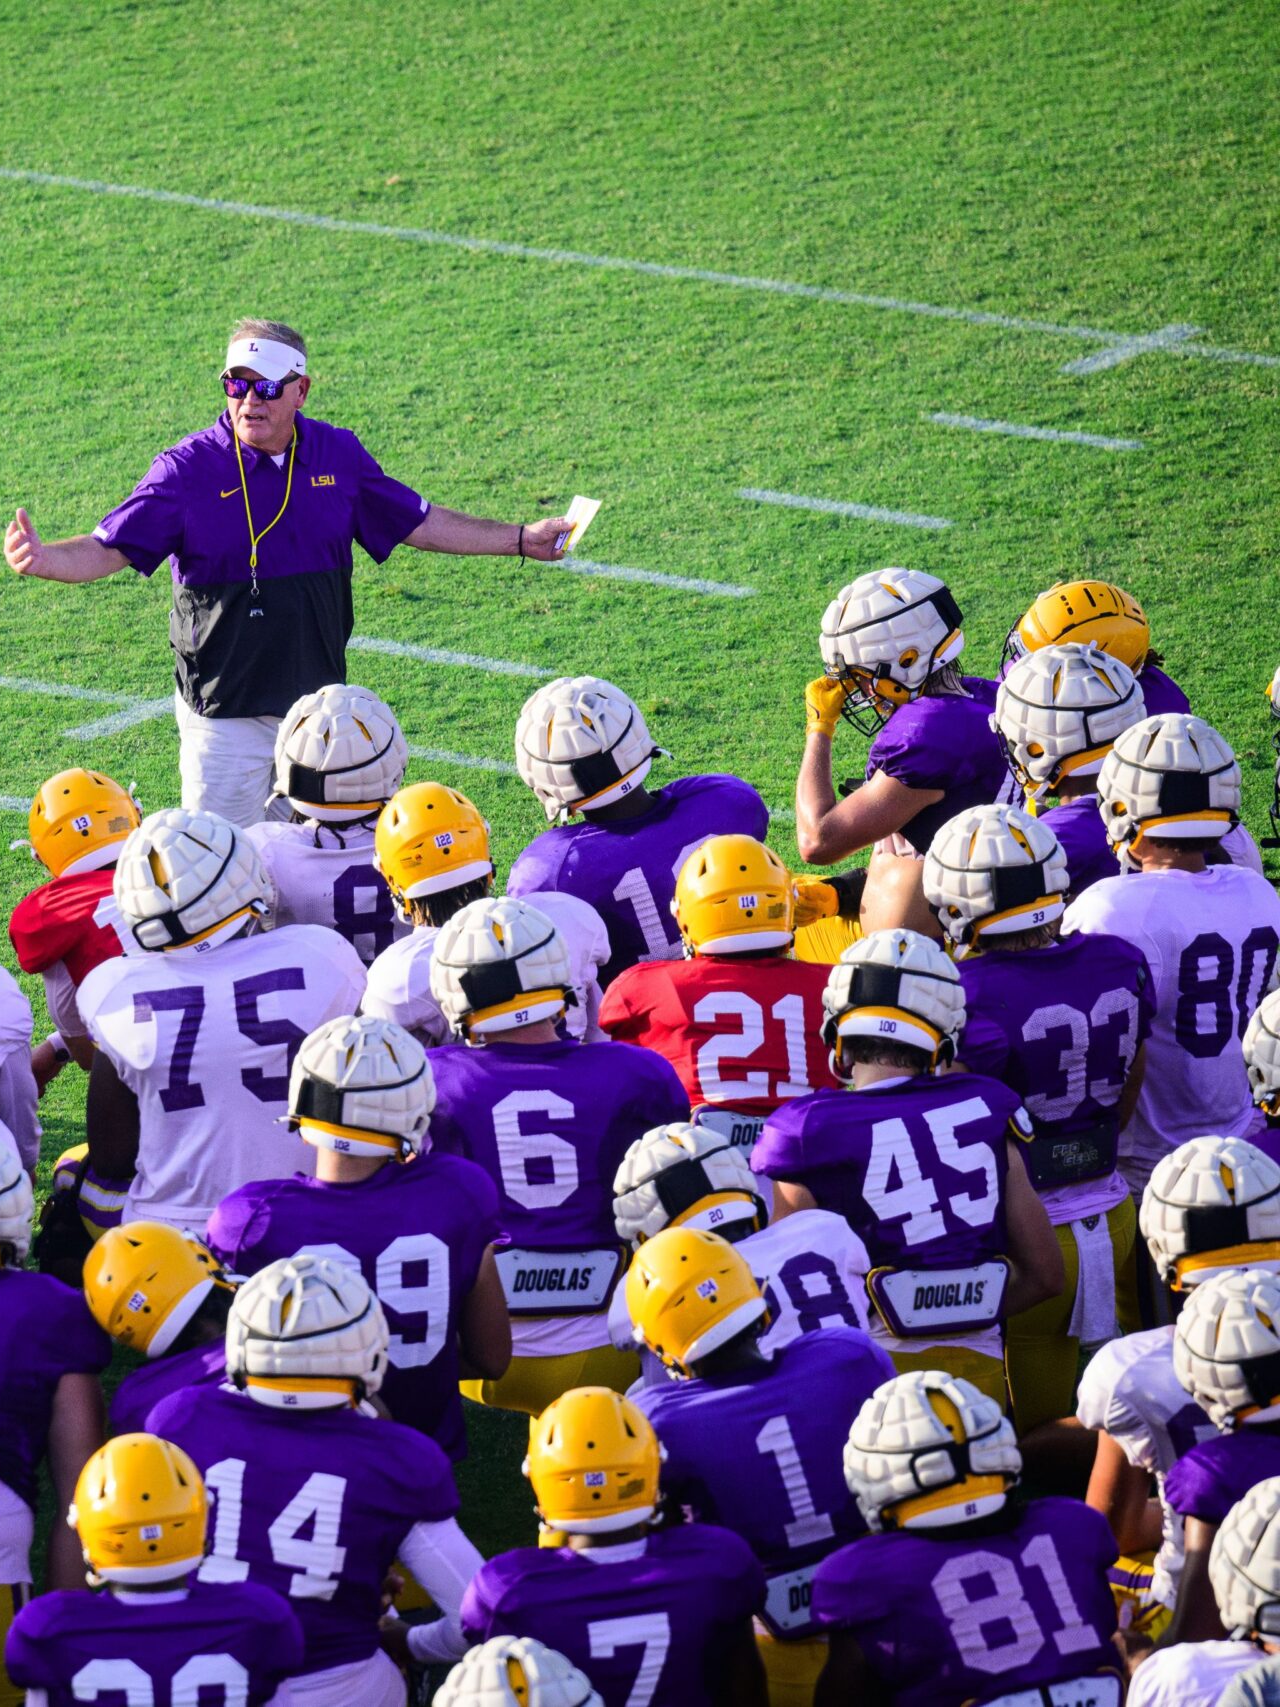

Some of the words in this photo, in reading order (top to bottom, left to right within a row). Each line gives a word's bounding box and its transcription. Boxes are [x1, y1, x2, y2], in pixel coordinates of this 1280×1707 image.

[248, 342, 259, 352] L
[311, 475, 336, 487] LSU
[621, 782, 632, 794] 91
[75, 817, 89, 829] 13
[435, 833, 452, 847] 122
[741, 896, 756, 908] 114
[1032, 911, 1046, 924] 33
[193, 941, 211, 953] 129
[1176, 926, 1279, 1058] 80
[515, 1010, 529, 1023] 97
[879, 1020, 896, 1033] 100
[133, 967, 307, 1112] 75
[693, 991, 820, 1102] 21
[1022, 987, 1139, 1122] 33
[334, 1139, 351, 1151] 102
[491, 1090, 579, 1210] 6
[862, 1097, 999, 1246] 45
[708, 1209, 724, 1223] 20
[513, 1267, 592, 1293] DOUGLAS
[291, 1233, 450, 1369] 9
[913, 1281, 988, 1311] DOUGLAS
[756, 1415, 835, 1548] 1
[197, 1457, 347, 1600] 14
[931, 1534, 1102, 1674] 81
[587, 1611, 672, 1707] 7
